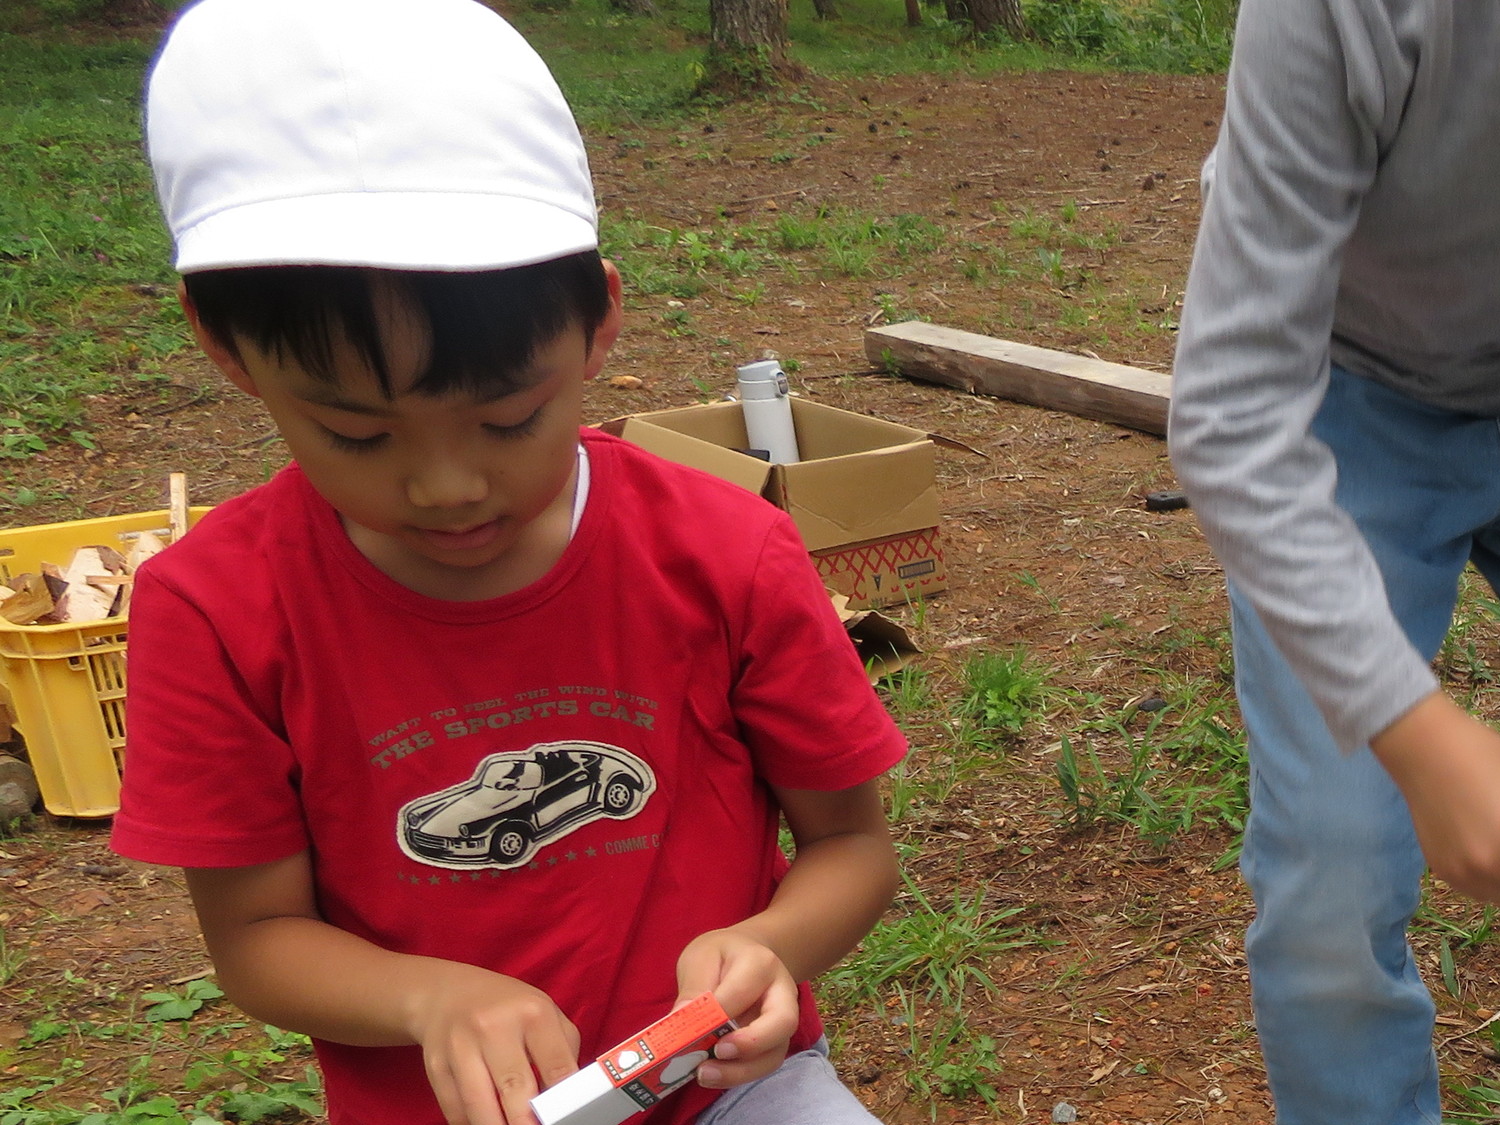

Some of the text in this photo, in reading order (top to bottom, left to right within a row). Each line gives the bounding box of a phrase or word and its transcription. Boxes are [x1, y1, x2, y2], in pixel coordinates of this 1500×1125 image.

[368, 717, 421, 747] WANT
[431, 707, 457, 721] TO
[515, 688, 549, 702] THE
[558, 685, 607, 697] WIND
[370, 700, 655, 769] THE SPORTS CAR
[605, 835, 649, 855] COMME
